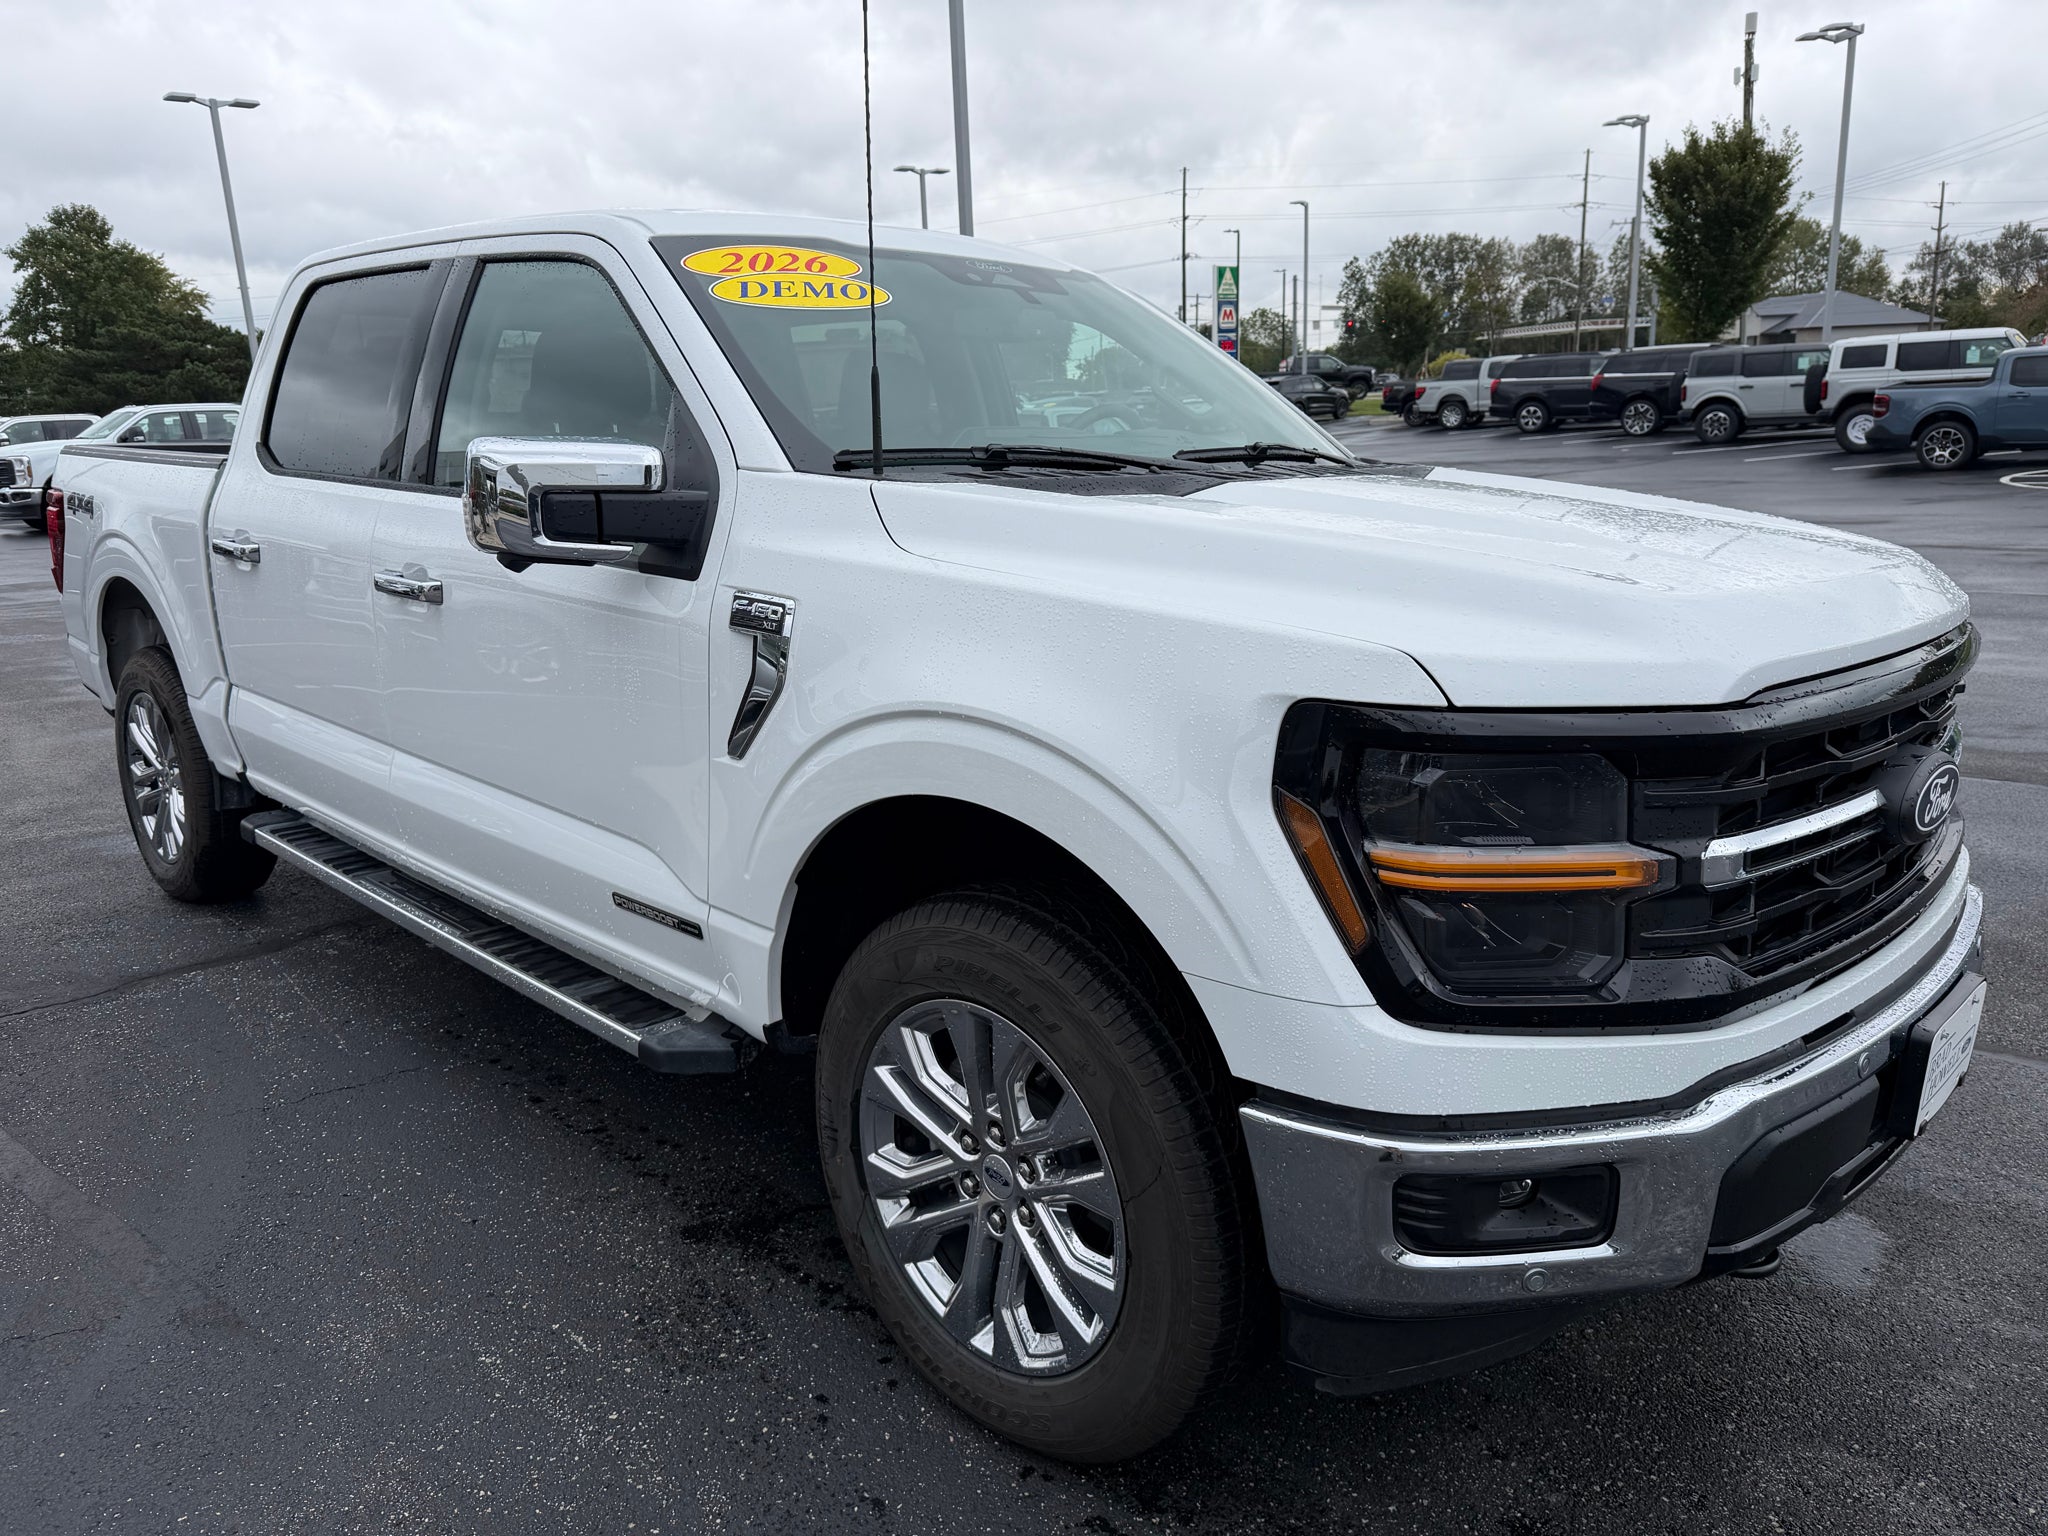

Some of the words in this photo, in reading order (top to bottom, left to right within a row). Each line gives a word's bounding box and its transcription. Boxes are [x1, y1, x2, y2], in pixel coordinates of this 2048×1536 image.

[718, 252, 828, 273] 2026
[737, 280, 868, 300] DEMO
[1222, 308, 1234, 321] M
[732, 599, 783, 621] F-150
[762, 620, 778, 631] XLT
[1924, 774, 1955, 824] Ford
[613, 895, 679, 929] POWERBOOST
[934, 955, 1064, 1033] PIRELLI
[890, 1319, 1052, 1432] SCORPION
